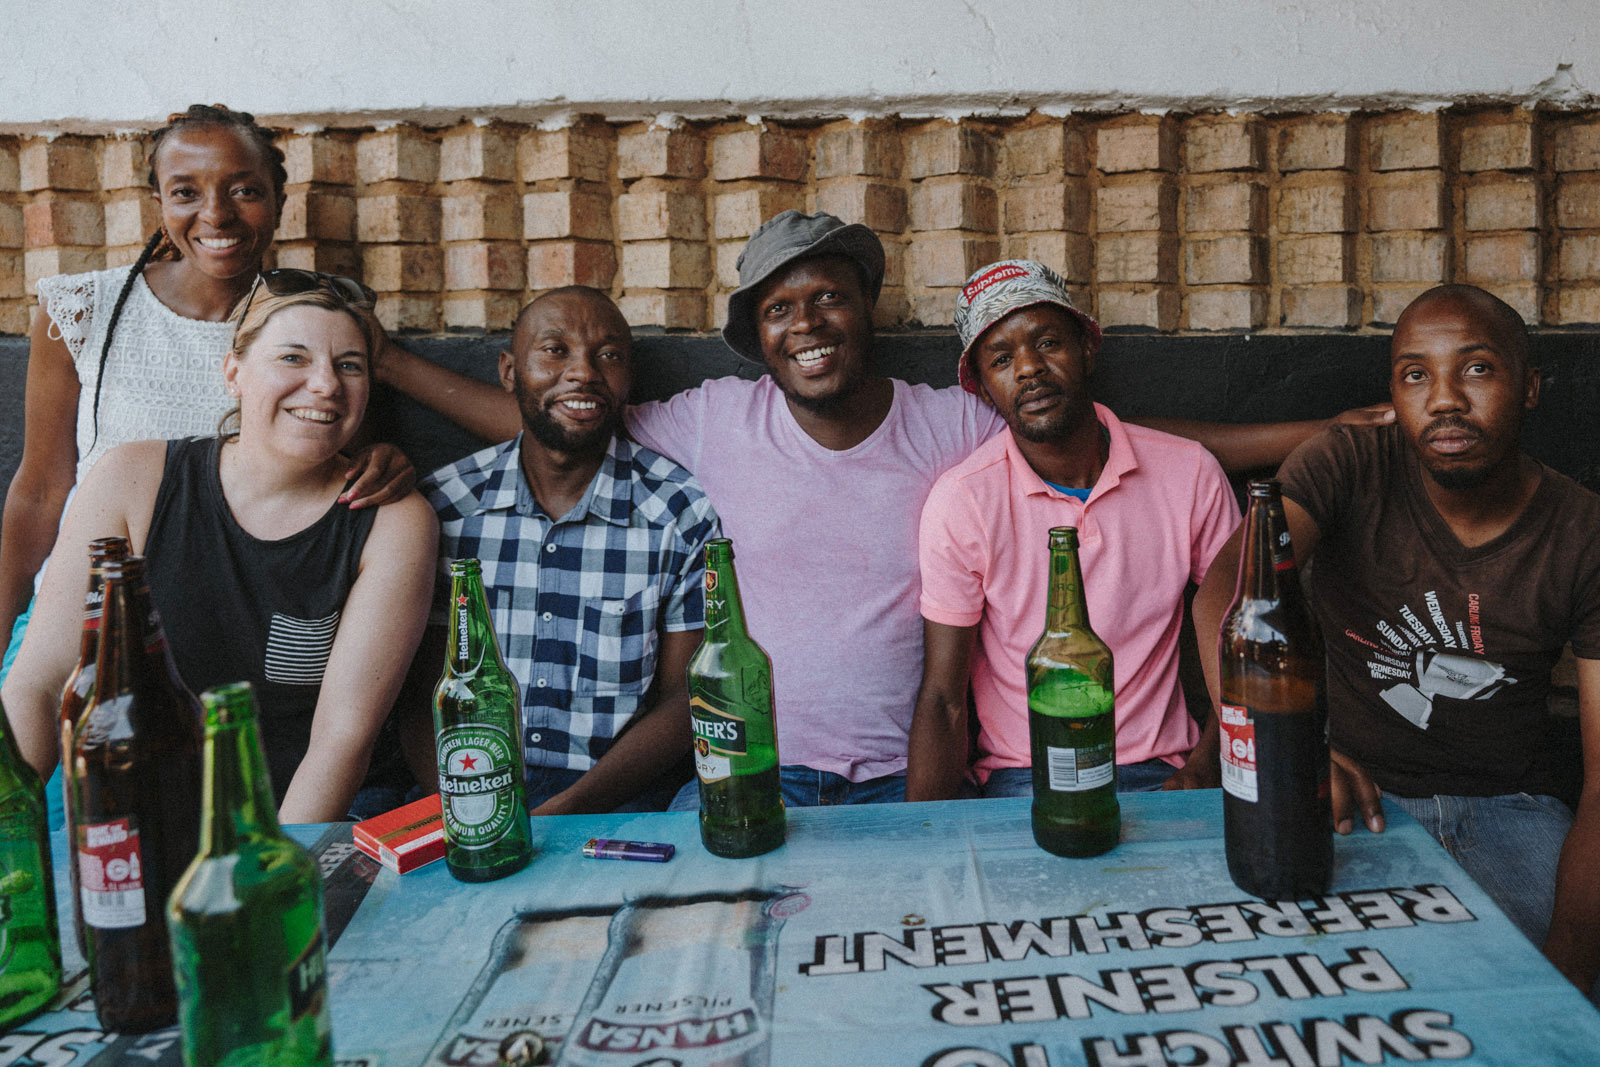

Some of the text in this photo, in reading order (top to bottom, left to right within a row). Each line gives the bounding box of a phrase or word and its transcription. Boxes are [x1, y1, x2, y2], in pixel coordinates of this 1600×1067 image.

[966, 267, 1025, 299] Supreme
[706, 599, 726, 610] RY
[1424, 590, 1457, 649] WEDNESDAY
[459, 608, 469, 660] Heineken
[1376, 619, 1412, 652] SUNDA
[1398, 604, 1437, 646] TUESDAY
[1469, 624, 1485, 655] FRIDAY
[1366, 661, 1412, 680] WEDNESDAY
[1373, 651, 1411, 670] THURSDAY
[692, 718, 738, 742] NTER'S
[440, 737, 462, 765] HEINEKEN
[463, 736, 489, 747] LAGER
[489, 741, 505, 761] BEER
[439, 771, 513, 794] Heineken
[445, 808, 476, 837] PREMIUM
[478, 804, 509, 835] QUALITY
[798, 884, 1477, 977] REFRESHMENT
[920, 945, 1411, 1027] PILSENER
[615, 995, 734, 1014] PILSENER
[483, 1014, 562, 1030] SENER
[587, 1010, 748, 1049] HANSA
[1083, 1009, 1474, 1067] SWITCH
